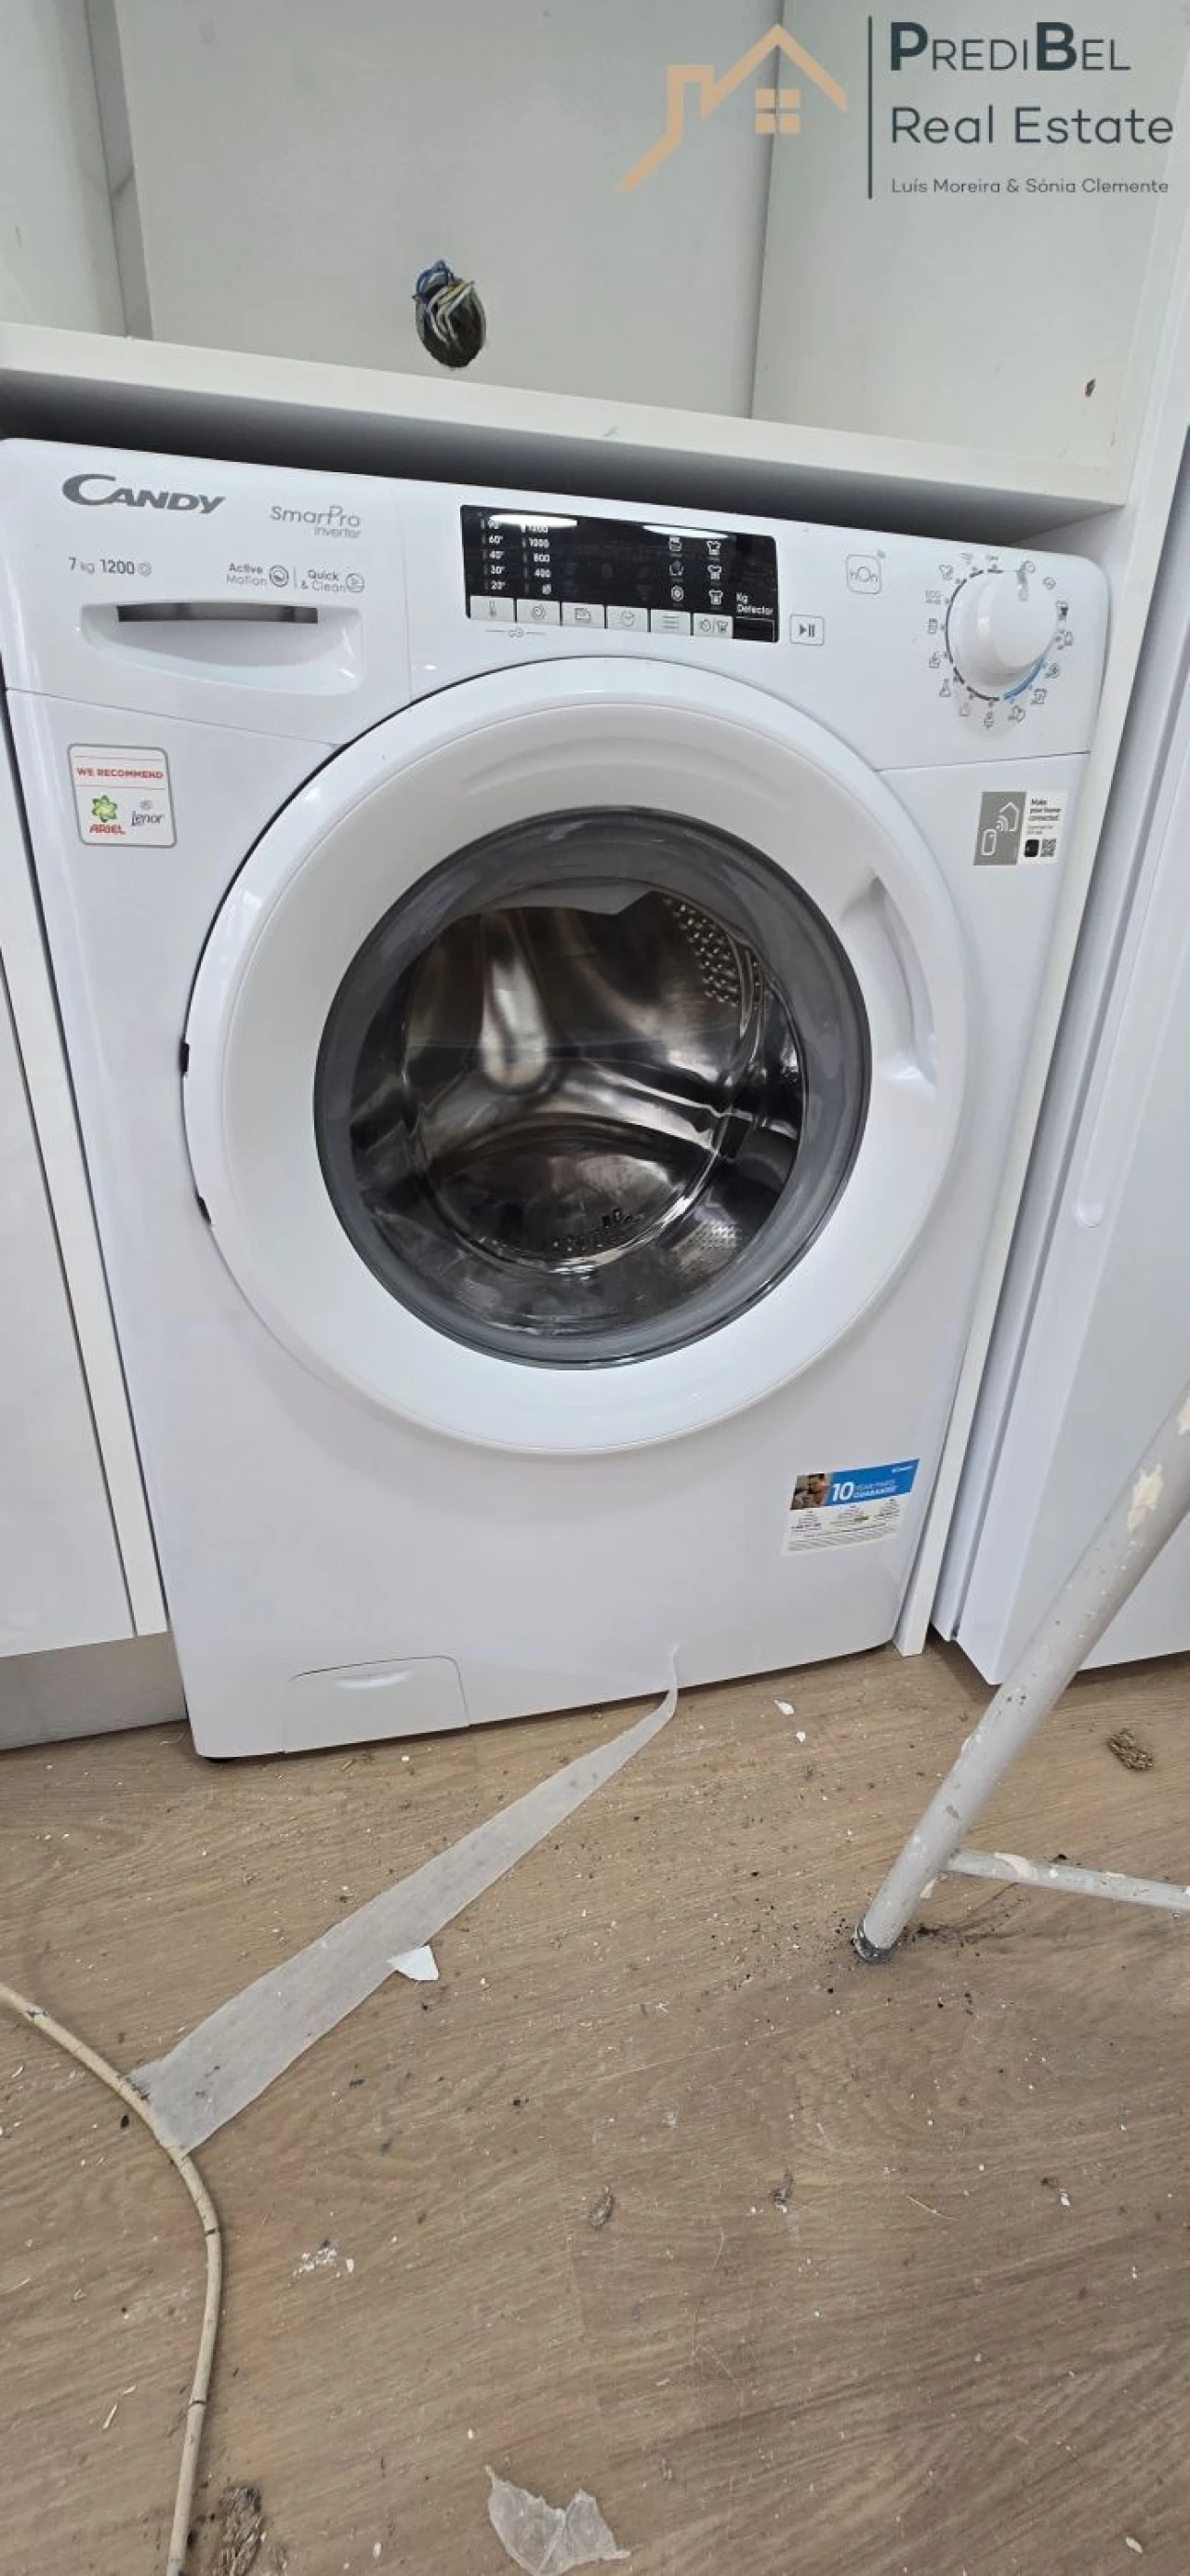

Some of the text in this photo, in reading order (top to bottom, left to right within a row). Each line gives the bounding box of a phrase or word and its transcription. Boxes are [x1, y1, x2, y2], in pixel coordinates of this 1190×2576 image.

[62, 473, 226, 514] CANDY
[534, 552, 550, 562] 800
[68, 556, 76, 571] 7
[99, 559, 135, 575] 1200
[228, 562, 264, 575] Active
[308, 569, 339, 581] Quick
[535, 568, 552, 578] 400
[226, 575, 268, 587] Motion
[311, 579, 347, 592] Clean
[735, 591, 748, 605] Kg
[735, 603, 774, 615] Detector
[77, 767, 165, 779] WE RECOMMEND
[832, 1481, 854, 1502] 10
